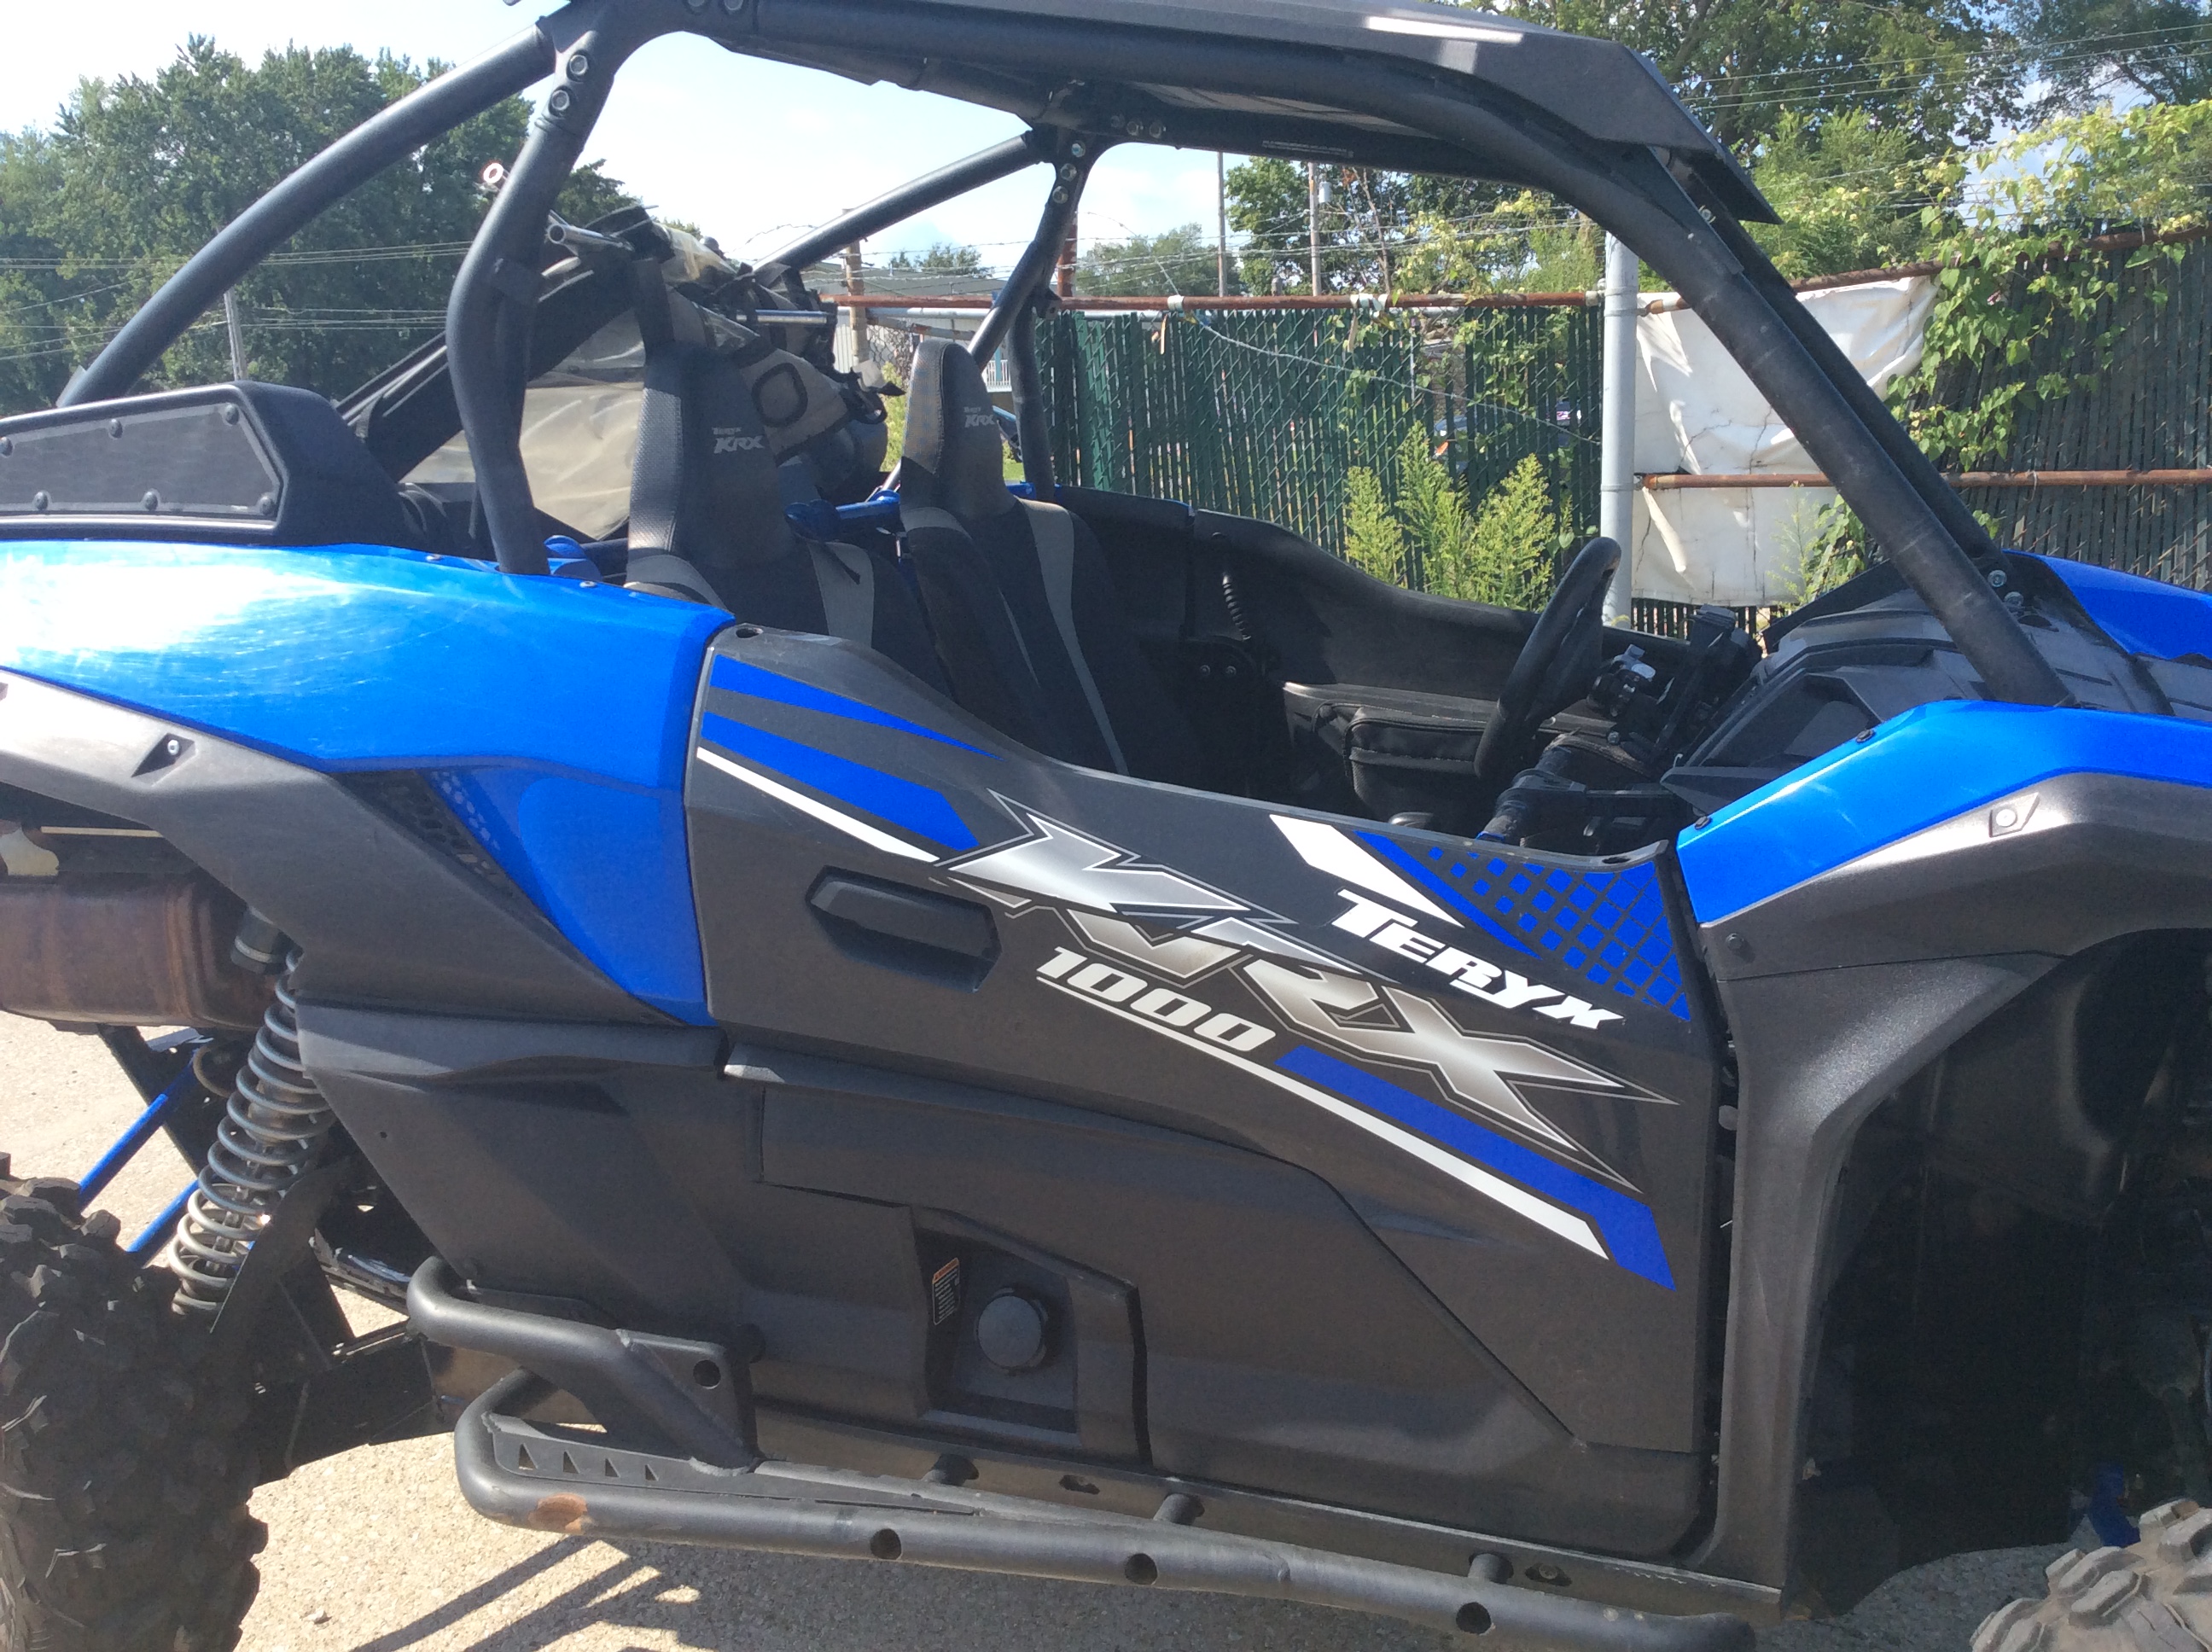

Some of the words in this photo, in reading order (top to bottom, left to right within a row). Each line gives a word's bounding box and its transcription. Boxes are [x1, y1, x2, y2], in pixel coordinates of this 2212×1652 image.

[713, 435, 765, 454] KRX
[964, 415, 996, 428] KRX
[1331, 888, 1625, 1030] TERYX
[1036, 946, 1277, 1052] 1000
